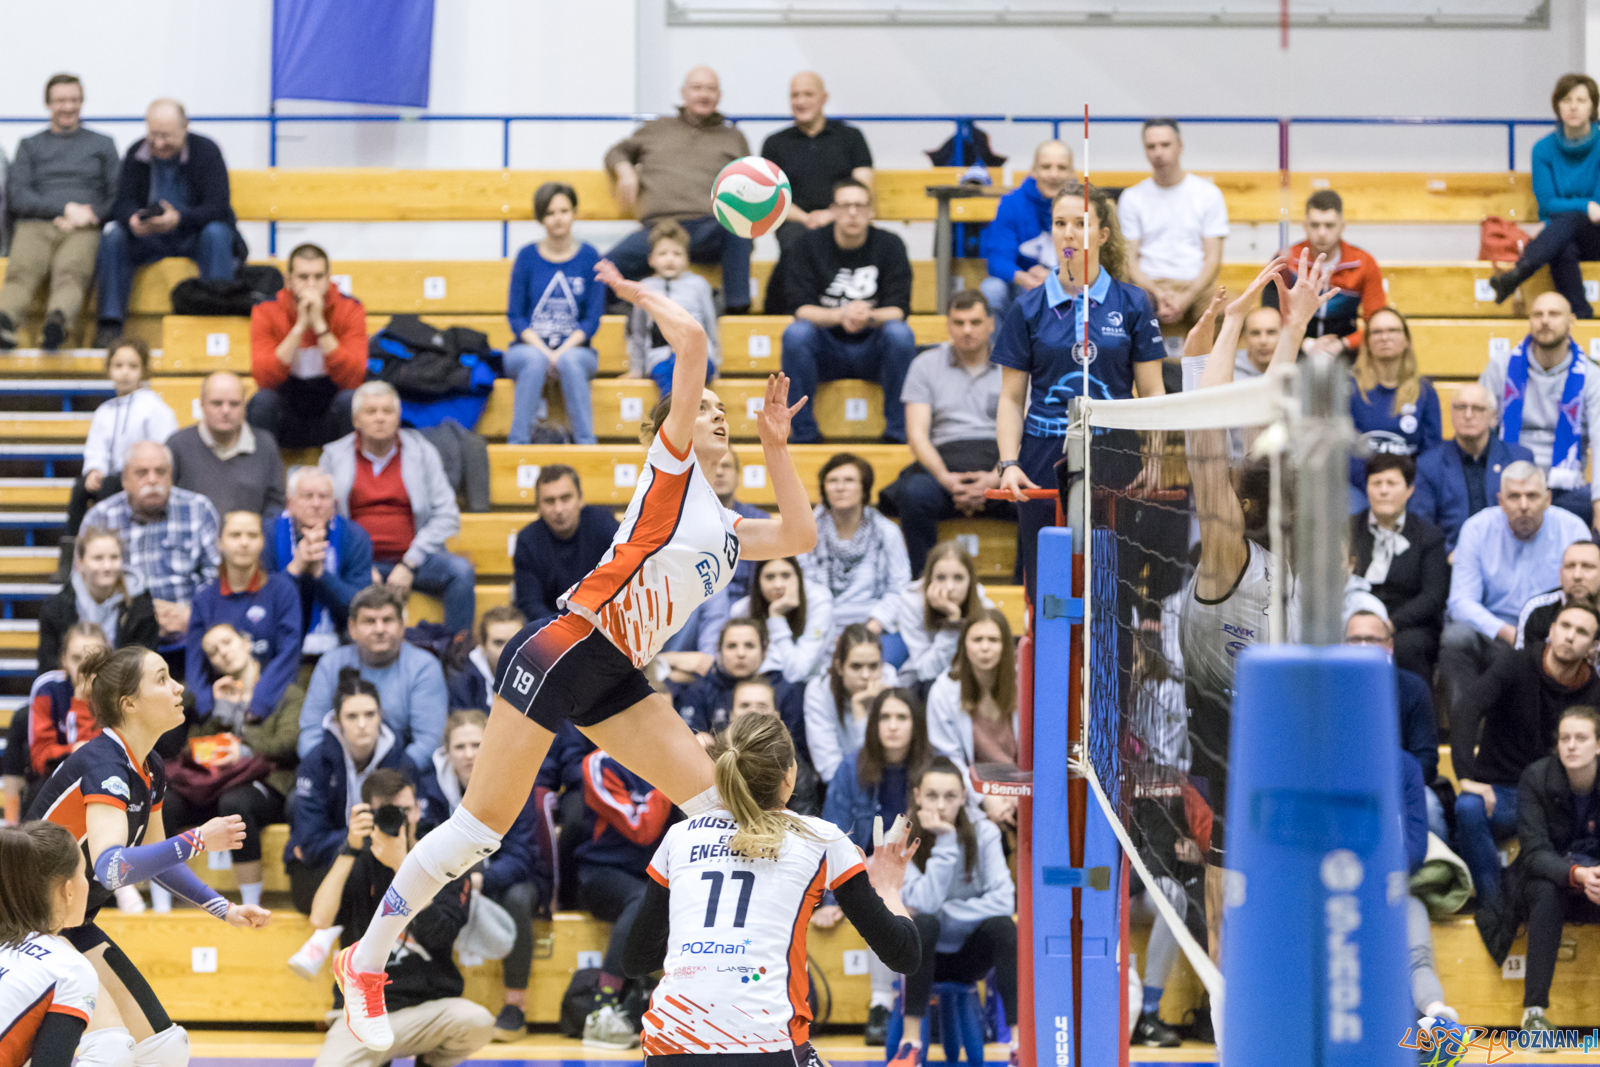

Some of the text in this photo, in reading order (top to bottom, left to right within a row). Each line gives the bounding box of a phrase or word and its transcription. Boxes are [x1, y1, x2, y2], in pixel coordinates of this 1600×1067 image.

[695, 558, 714, 597] Enea
[512, 665, 535, 695] 19
[990, 783, 1032, 796] Senoh
[700, 870, 756, 928] 11
[1055, 1016, 1069, 1067] enoh
